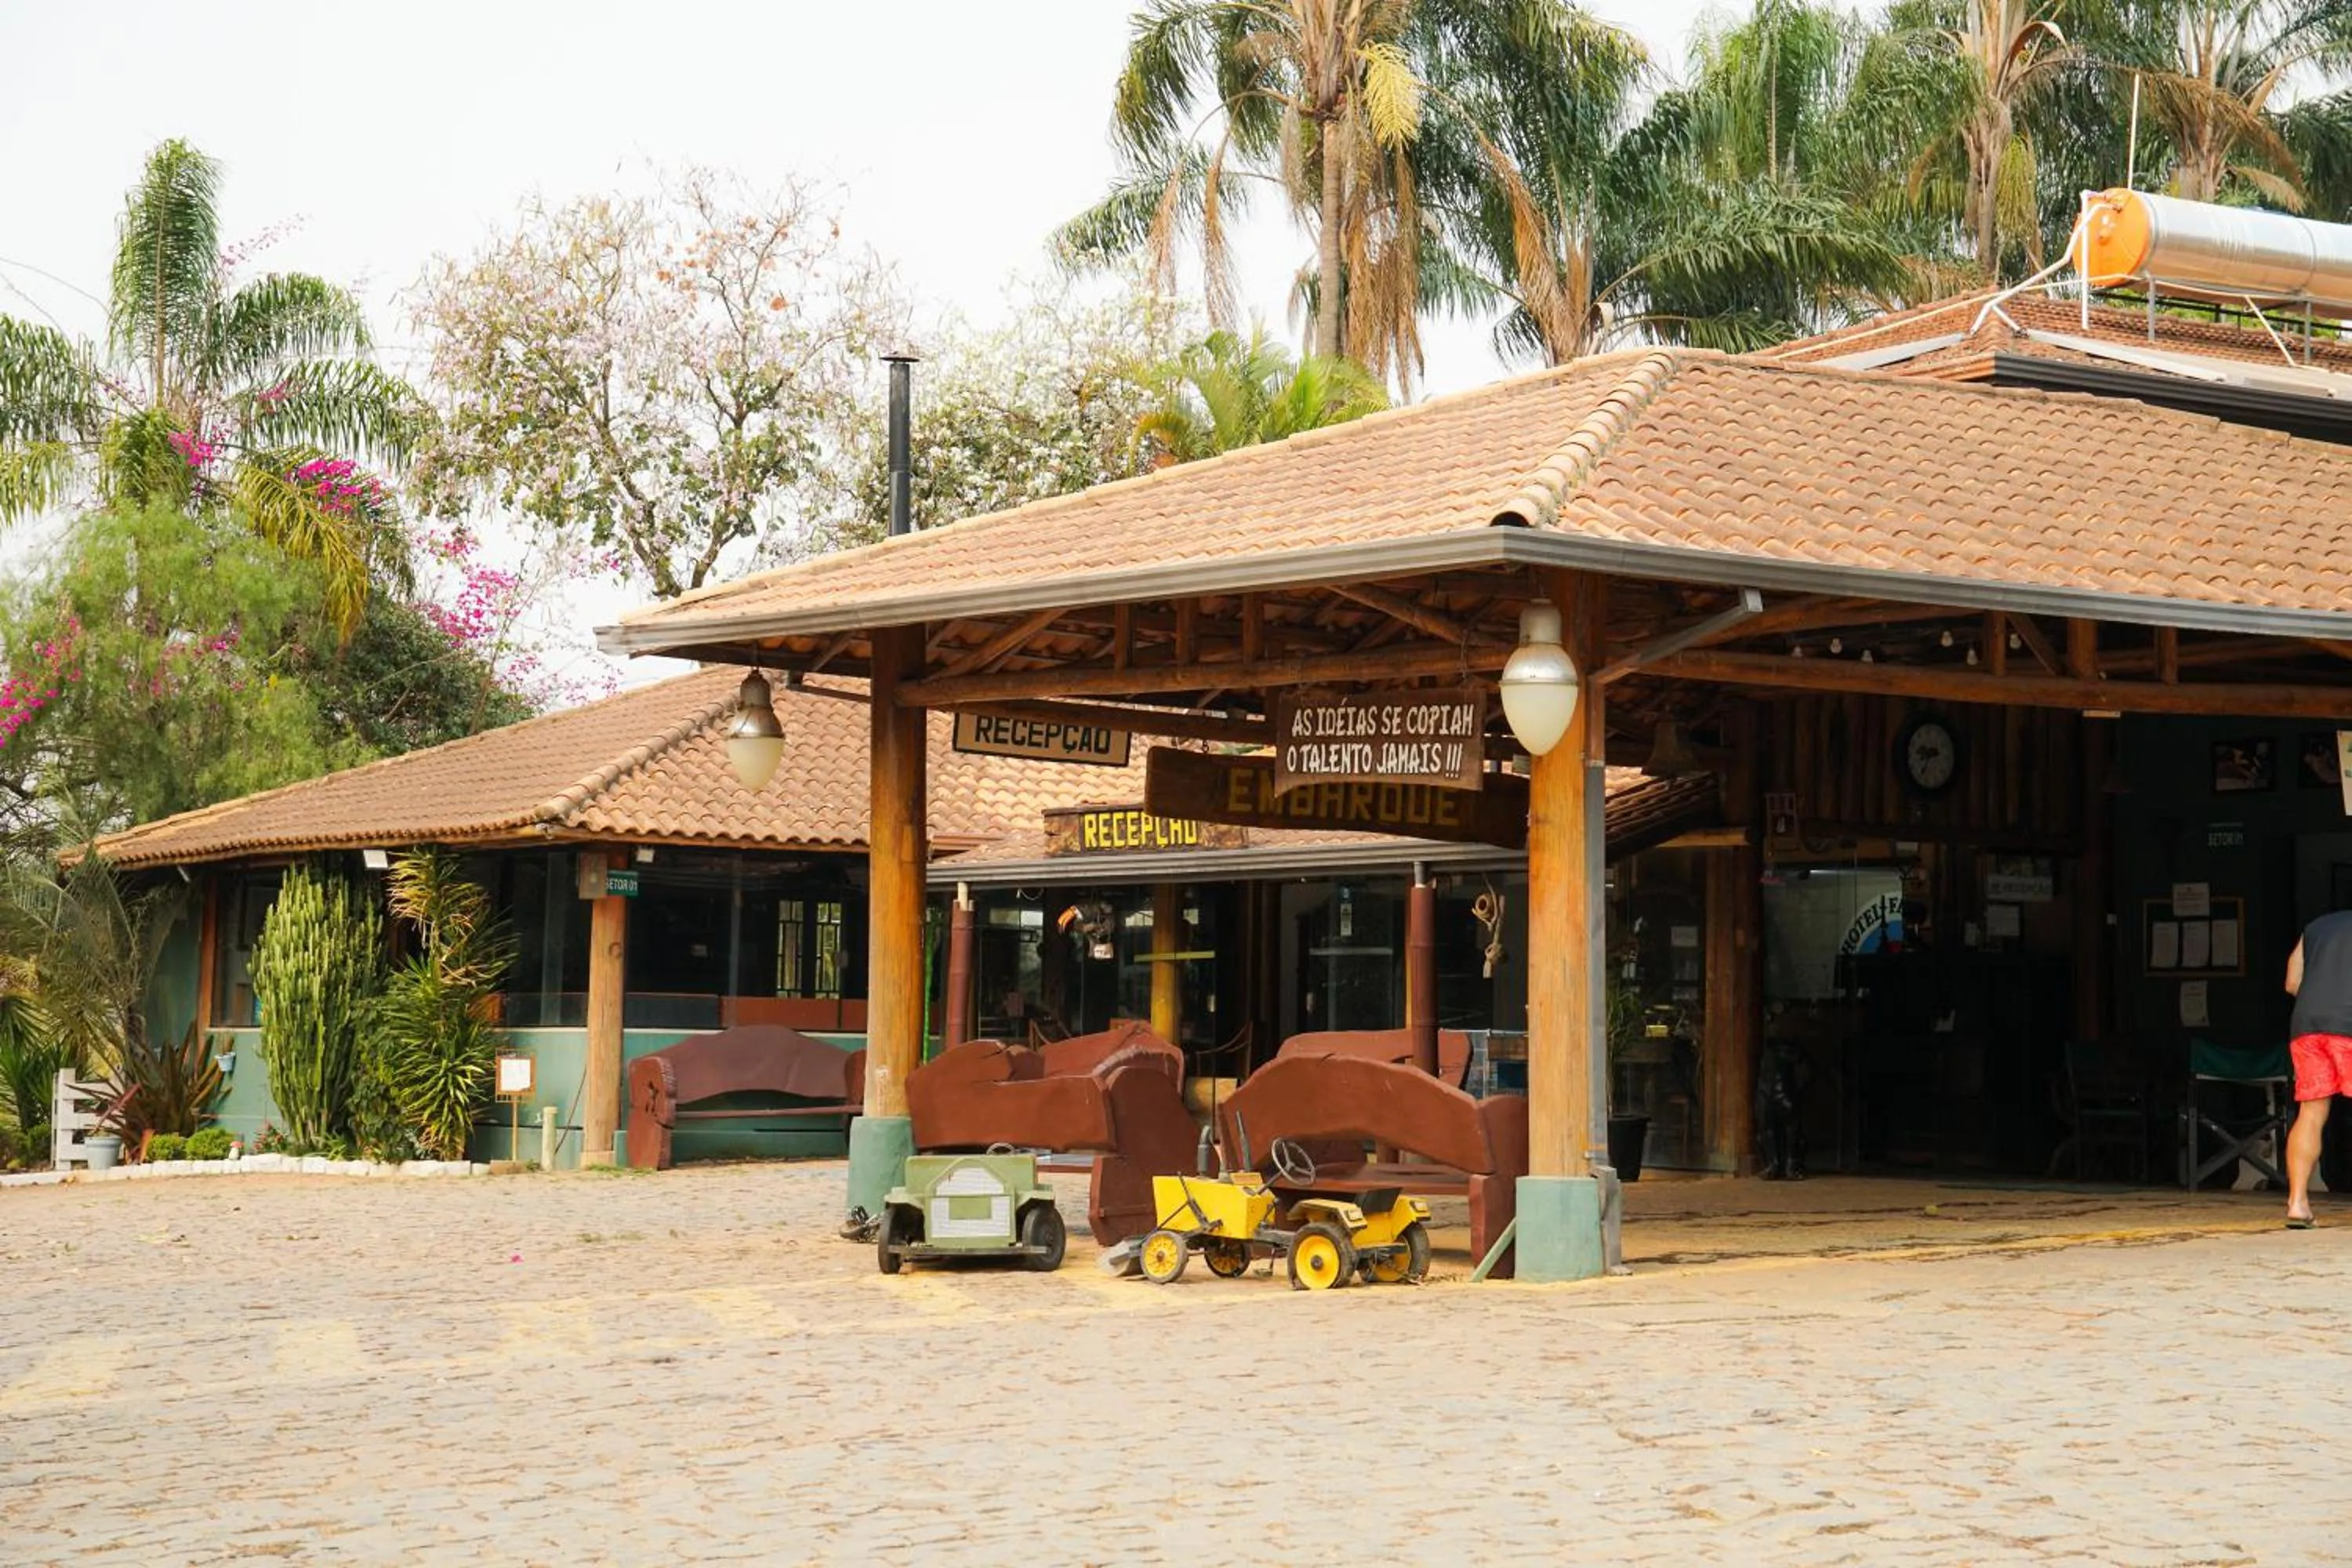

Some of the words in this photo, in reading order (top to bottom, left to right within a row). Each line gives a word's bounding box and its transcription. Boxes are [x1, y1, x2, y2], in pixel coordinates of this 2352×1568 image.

[1291, 708, 1313, 736] AS
[1316, 698, 1377, 736] IDÉIAS
[1381, 705, 1402, 735] SE
[1287, 745, 1298, 773] O
[1300, 743, 1373, 774] TALENTO
[1376, 742, 1442, 774] JAMAIS
